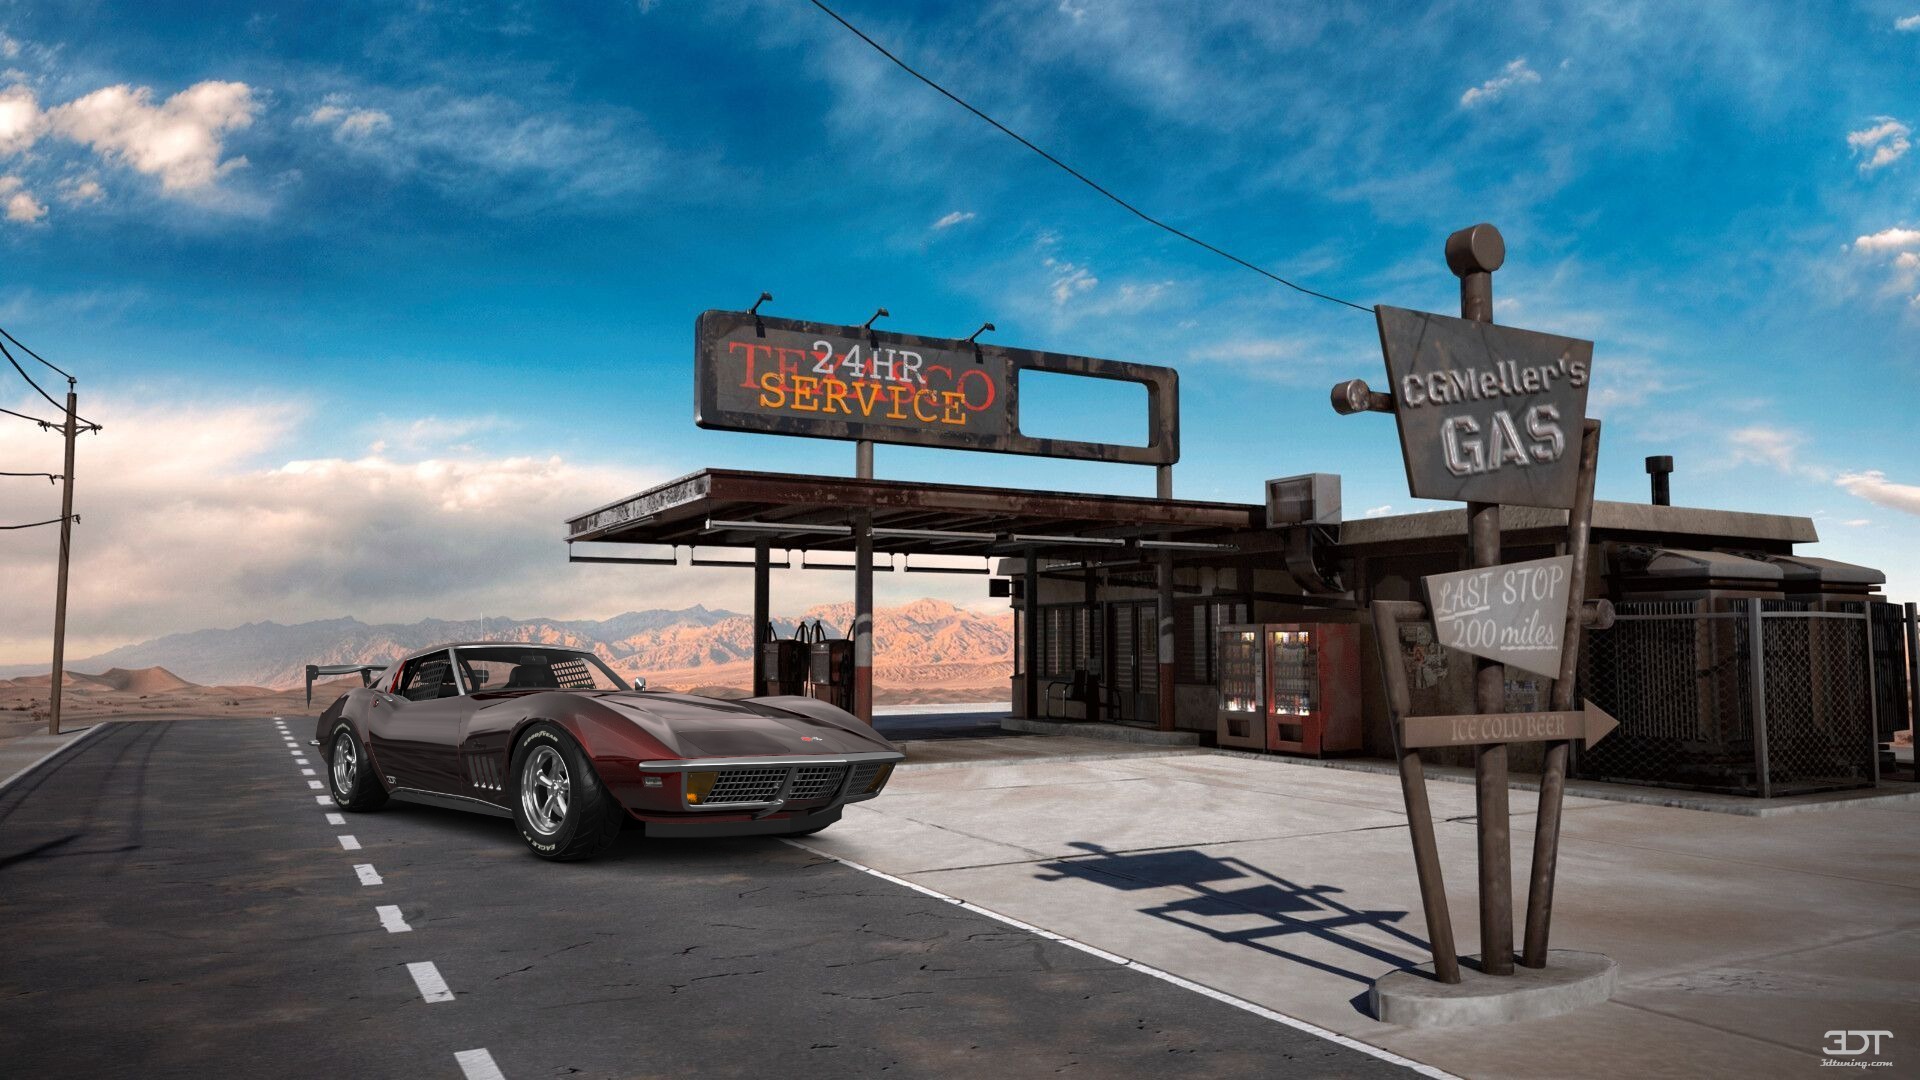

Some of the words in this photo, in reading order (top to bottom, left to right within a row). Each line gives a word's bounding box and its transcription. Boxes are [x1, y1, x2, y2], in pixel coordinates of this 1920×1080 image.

[813, 340, 926, 384] 24HR
[760, 371, 966, 425] SERVICE
[1440, 403, 1566, 477] GAS
[1438, 572, 1493, 614] LAST
[1502, 565, 1563, 605] STOP
[1452, 618, 1498, 649] 200
[1500, 608, 1555, 647] miles
[1452, 717, 1478, 741] ICE
[1480, 716, 1523, 740] COLD
[1526, 714, 1566, 737] BEER
